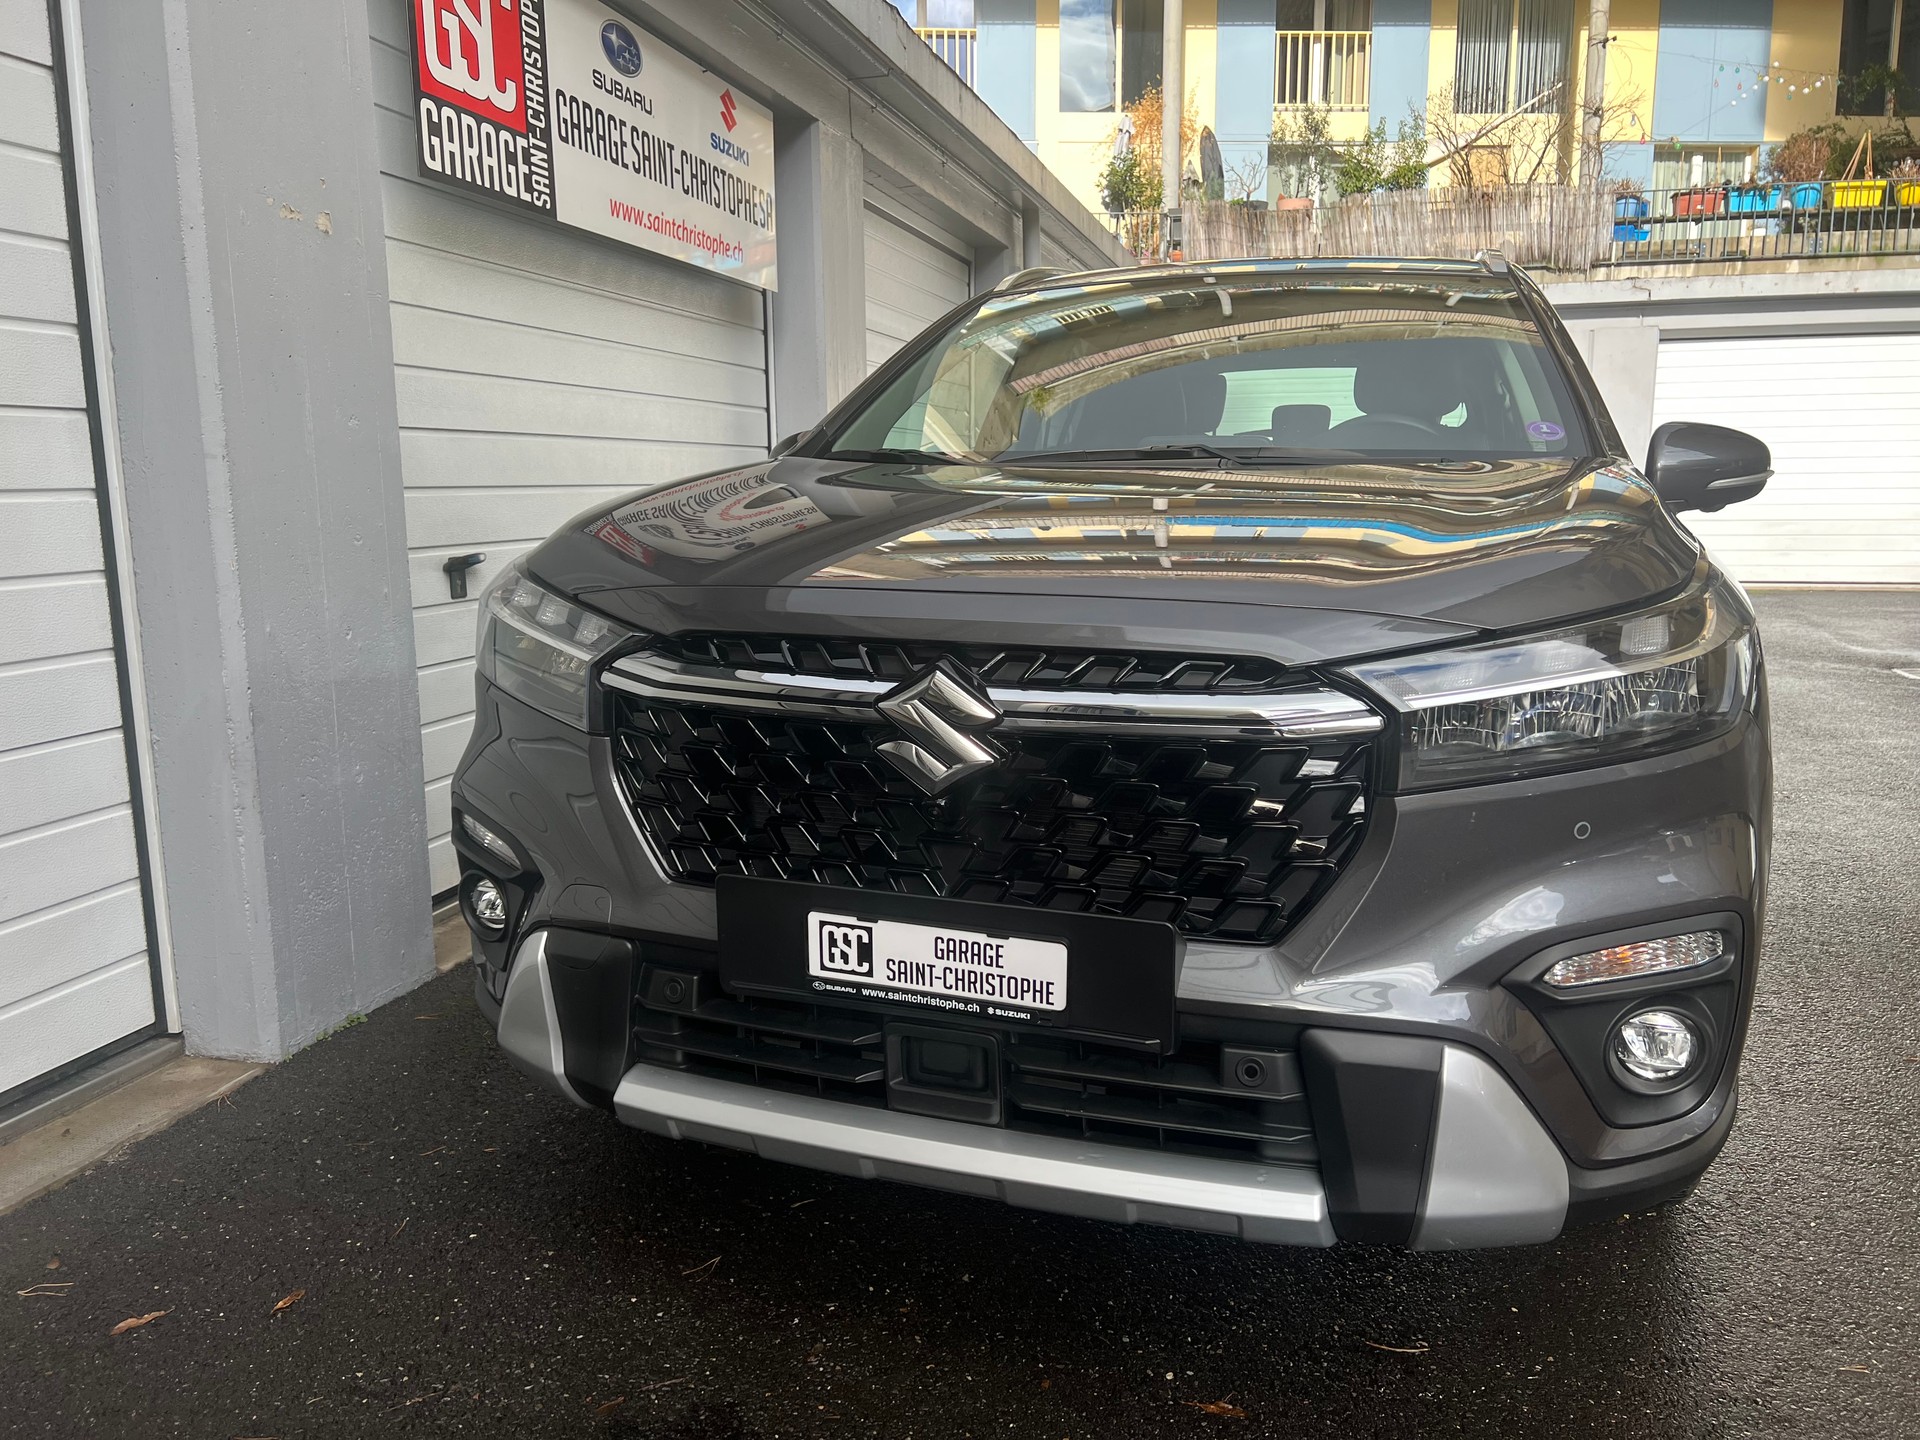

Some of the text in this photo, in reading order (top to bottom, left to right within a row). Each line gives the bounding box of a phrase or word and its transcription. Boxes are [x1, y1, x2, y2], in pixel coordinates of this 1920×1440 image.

[519, 0, 551, 210] SAINT-CHRISTOP
[591, 69, 653, 116] SUBARU
[420, 97, 533, 203] GARAGE
[555, 88, 774, 233] GARAGE SAINT-CHRISTOPHE SA
[709, 131, 750, 167] SUZUKI
[608, 198, 744, 263] www.saintchristophe.ch
[821, 924, 870, 973] GSC
[933, 935, 1005, 969] GARAGE
[825, 983, 1031, 1020] SUBARU www.saintchristophe.ch SUZUKI
[885, 958, 1056, 1006] SAINT-CHRISTOPHE
